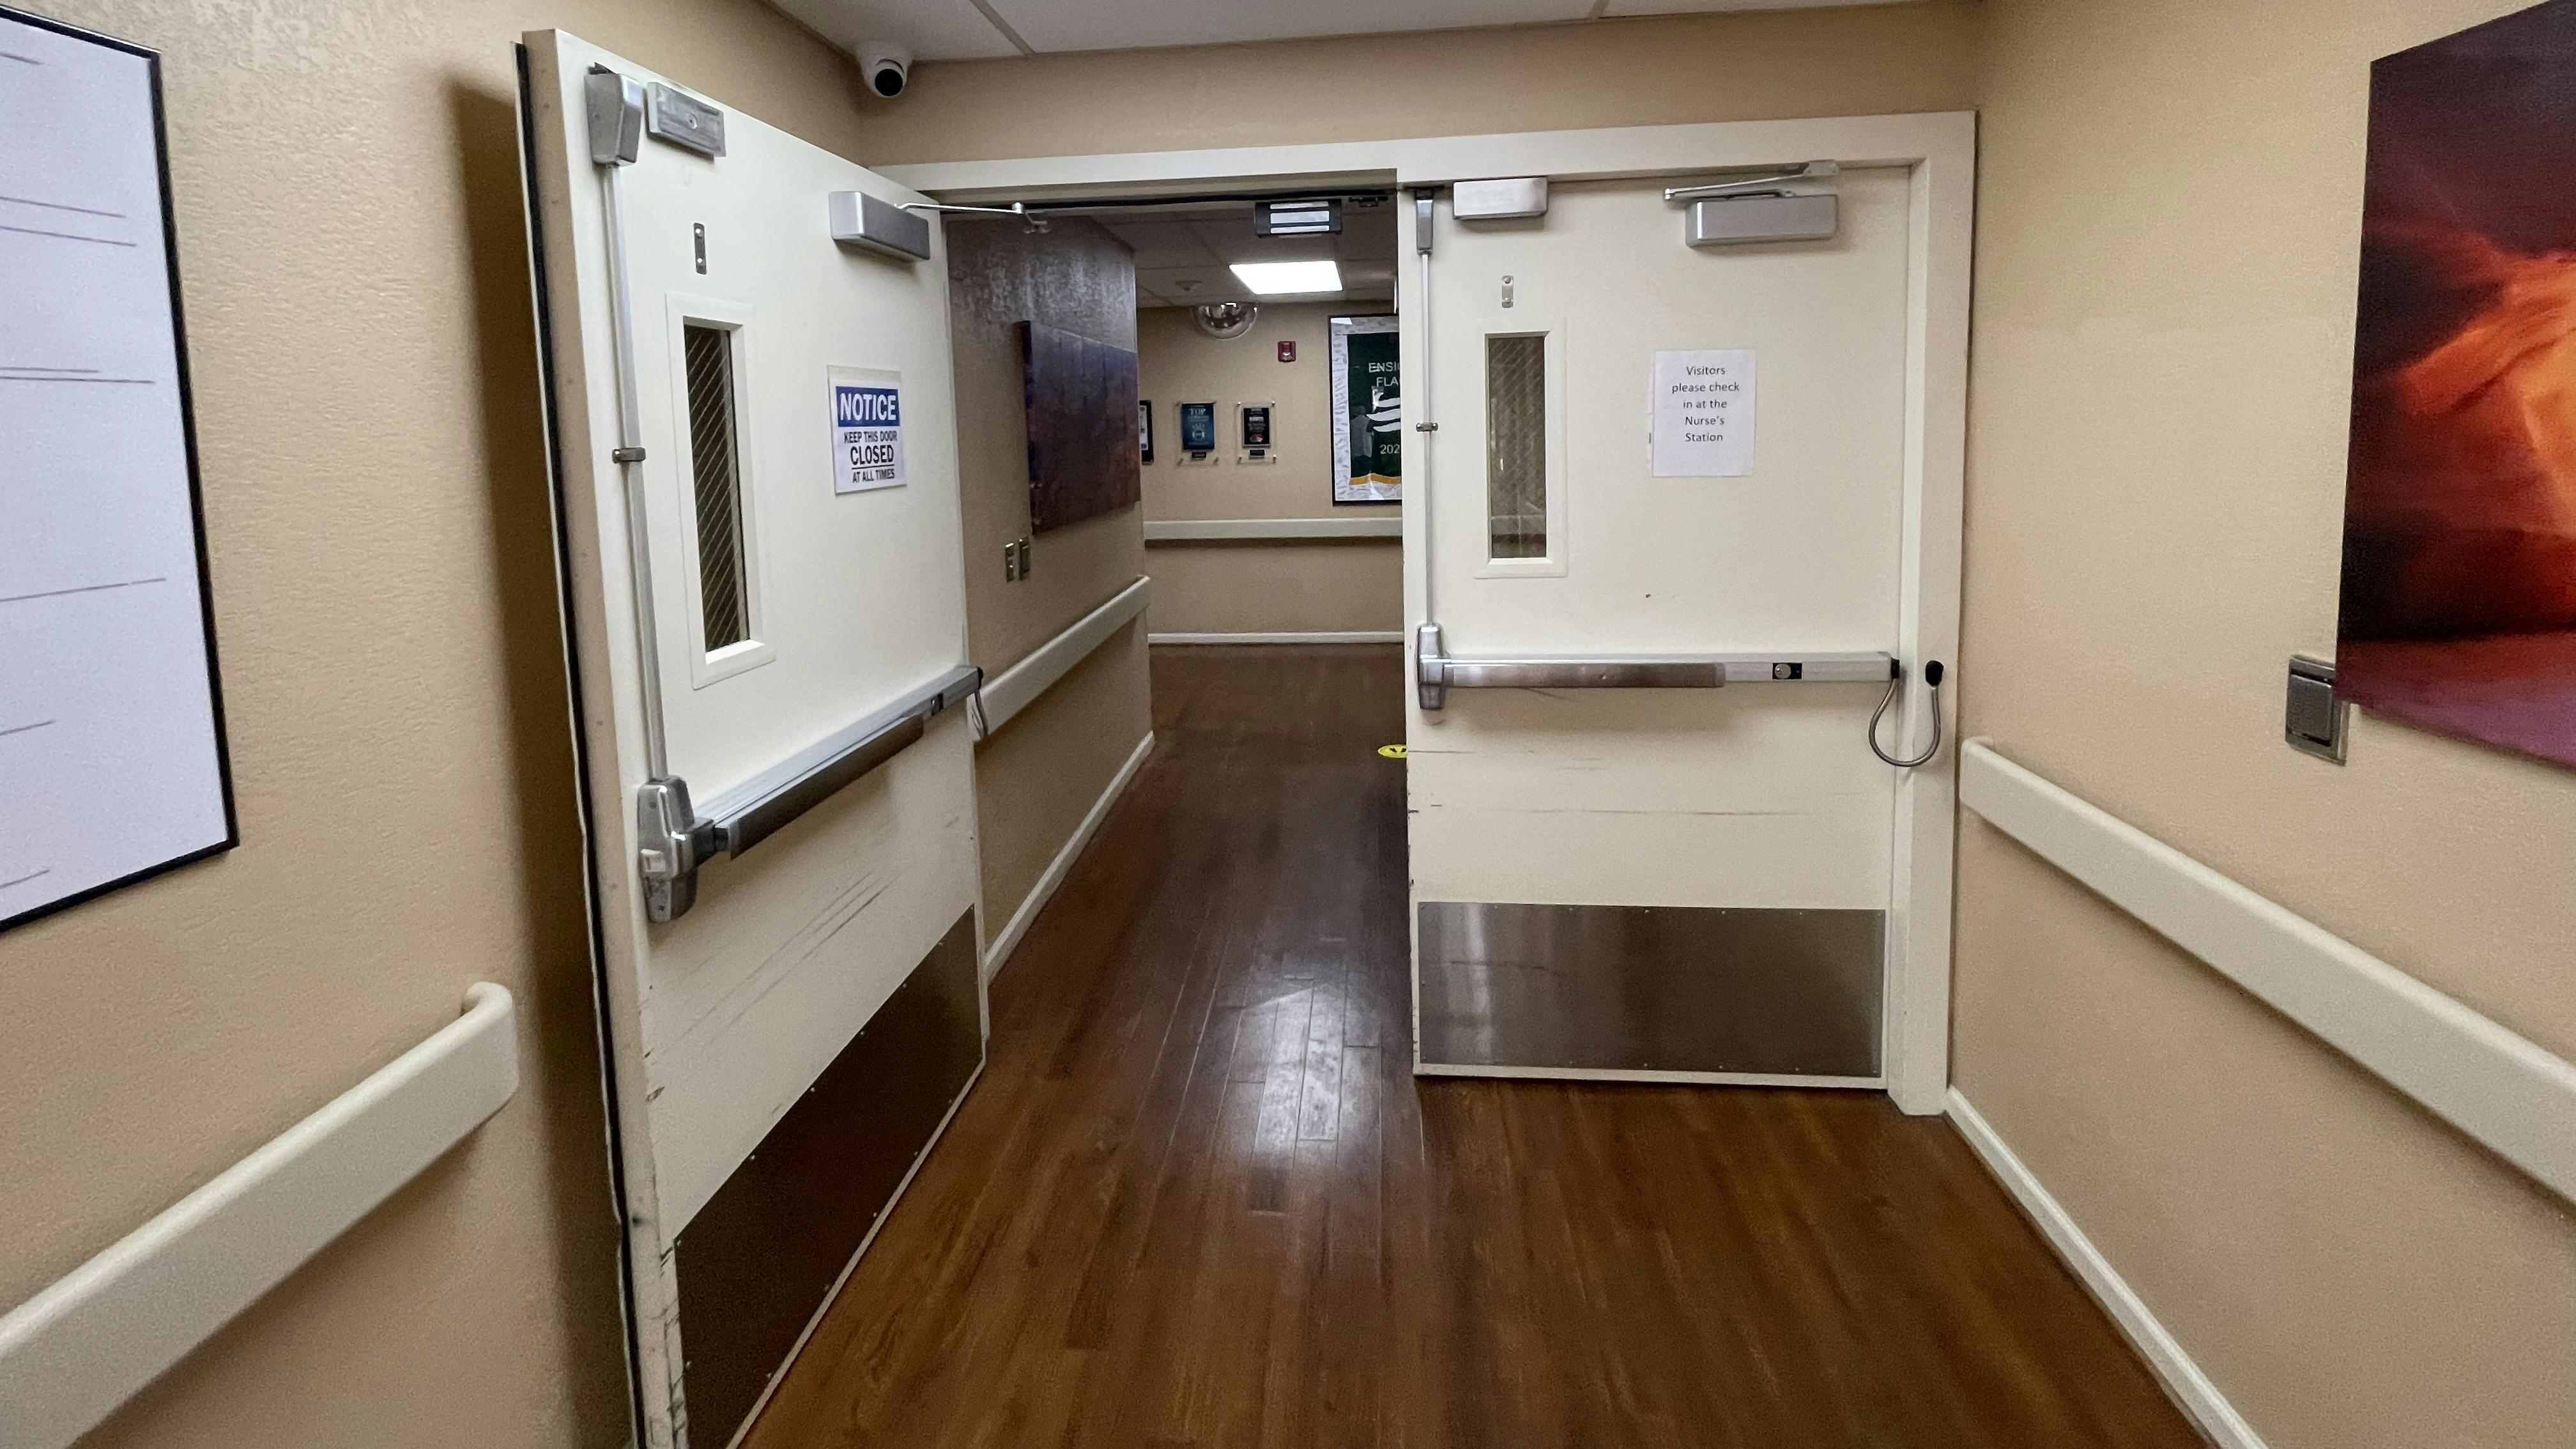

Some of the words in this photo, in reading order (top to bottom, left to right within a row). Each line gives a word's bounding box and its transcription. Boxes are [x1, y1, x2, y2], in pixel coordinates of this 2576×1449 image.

[1685, 366, 1726, 376] Visitors
[1376, 376, 1400, 387] FLA
[1671, 382, 1706, 394] please
[1709, 381, 1740, 392] check
[839, 392, 897, 422] NOTICE
[1683, 399, 1693, 409] in
[1696, 401, 1706, 409] at
[1710, 399, 1728, 408] the
[1685, 416, 1725, 425] Nurse's
[843, 431, 862, 443] KEEP
[864, 431, 878, 443] THIS
[880, 430, 898, 442] DOOR
[1685, 433, 1723, 442] Station
[850, 444, 894, 466] CLOSED
[852, 471, 861, 484] AT
[862, 470, 875, 482] ALL
[875, 468, 895, 480] TIMES
